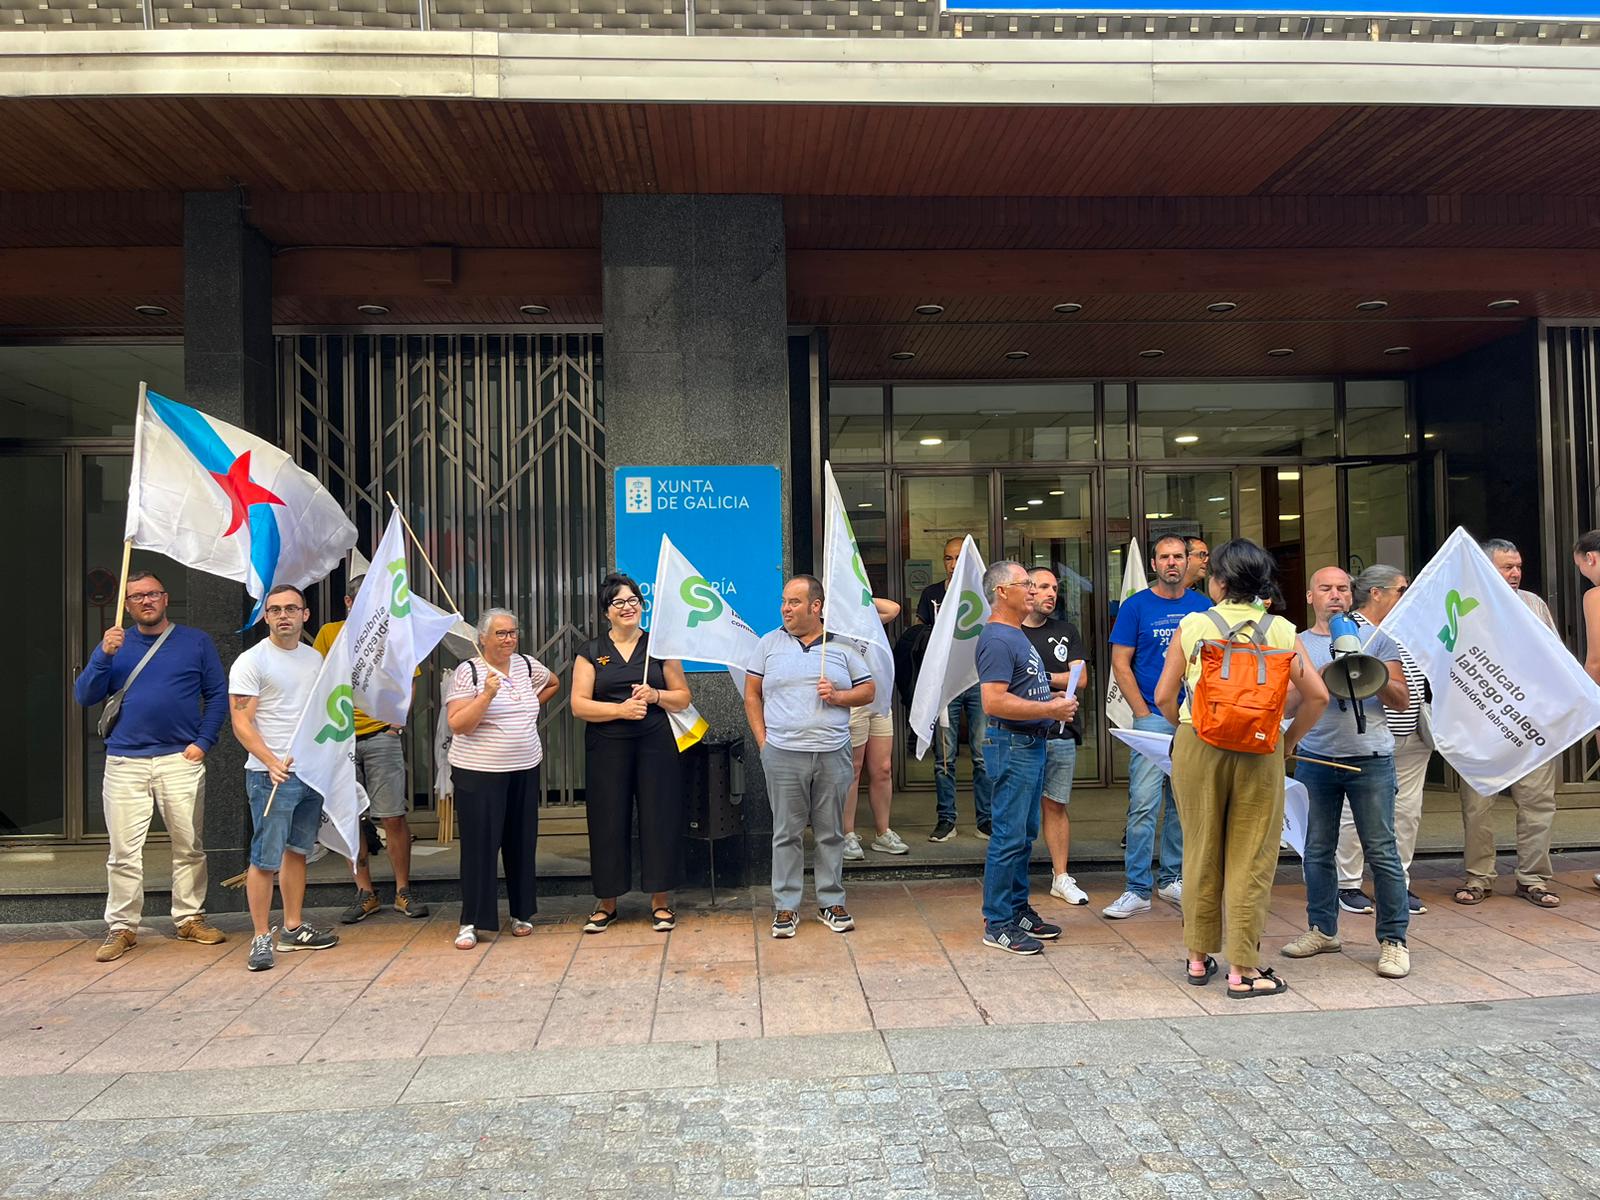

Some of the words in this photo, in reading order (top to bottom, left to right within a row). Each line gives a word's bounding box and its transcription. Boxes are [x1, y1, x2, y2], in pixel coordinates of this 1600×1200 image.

[657, 480, 714, 493] XUNTA
[657, 497, 678, 510] DE
[684, 496, 750, 509] GALICIA
[1455, 654, 1503, 704] labrego
[1500, 704, 1546, 746] galego
[1468, 646, 1526, 701] sindicato
[1449, 668, 1487, 711] omisións
[1485, 709, 1524, 748] labregas
